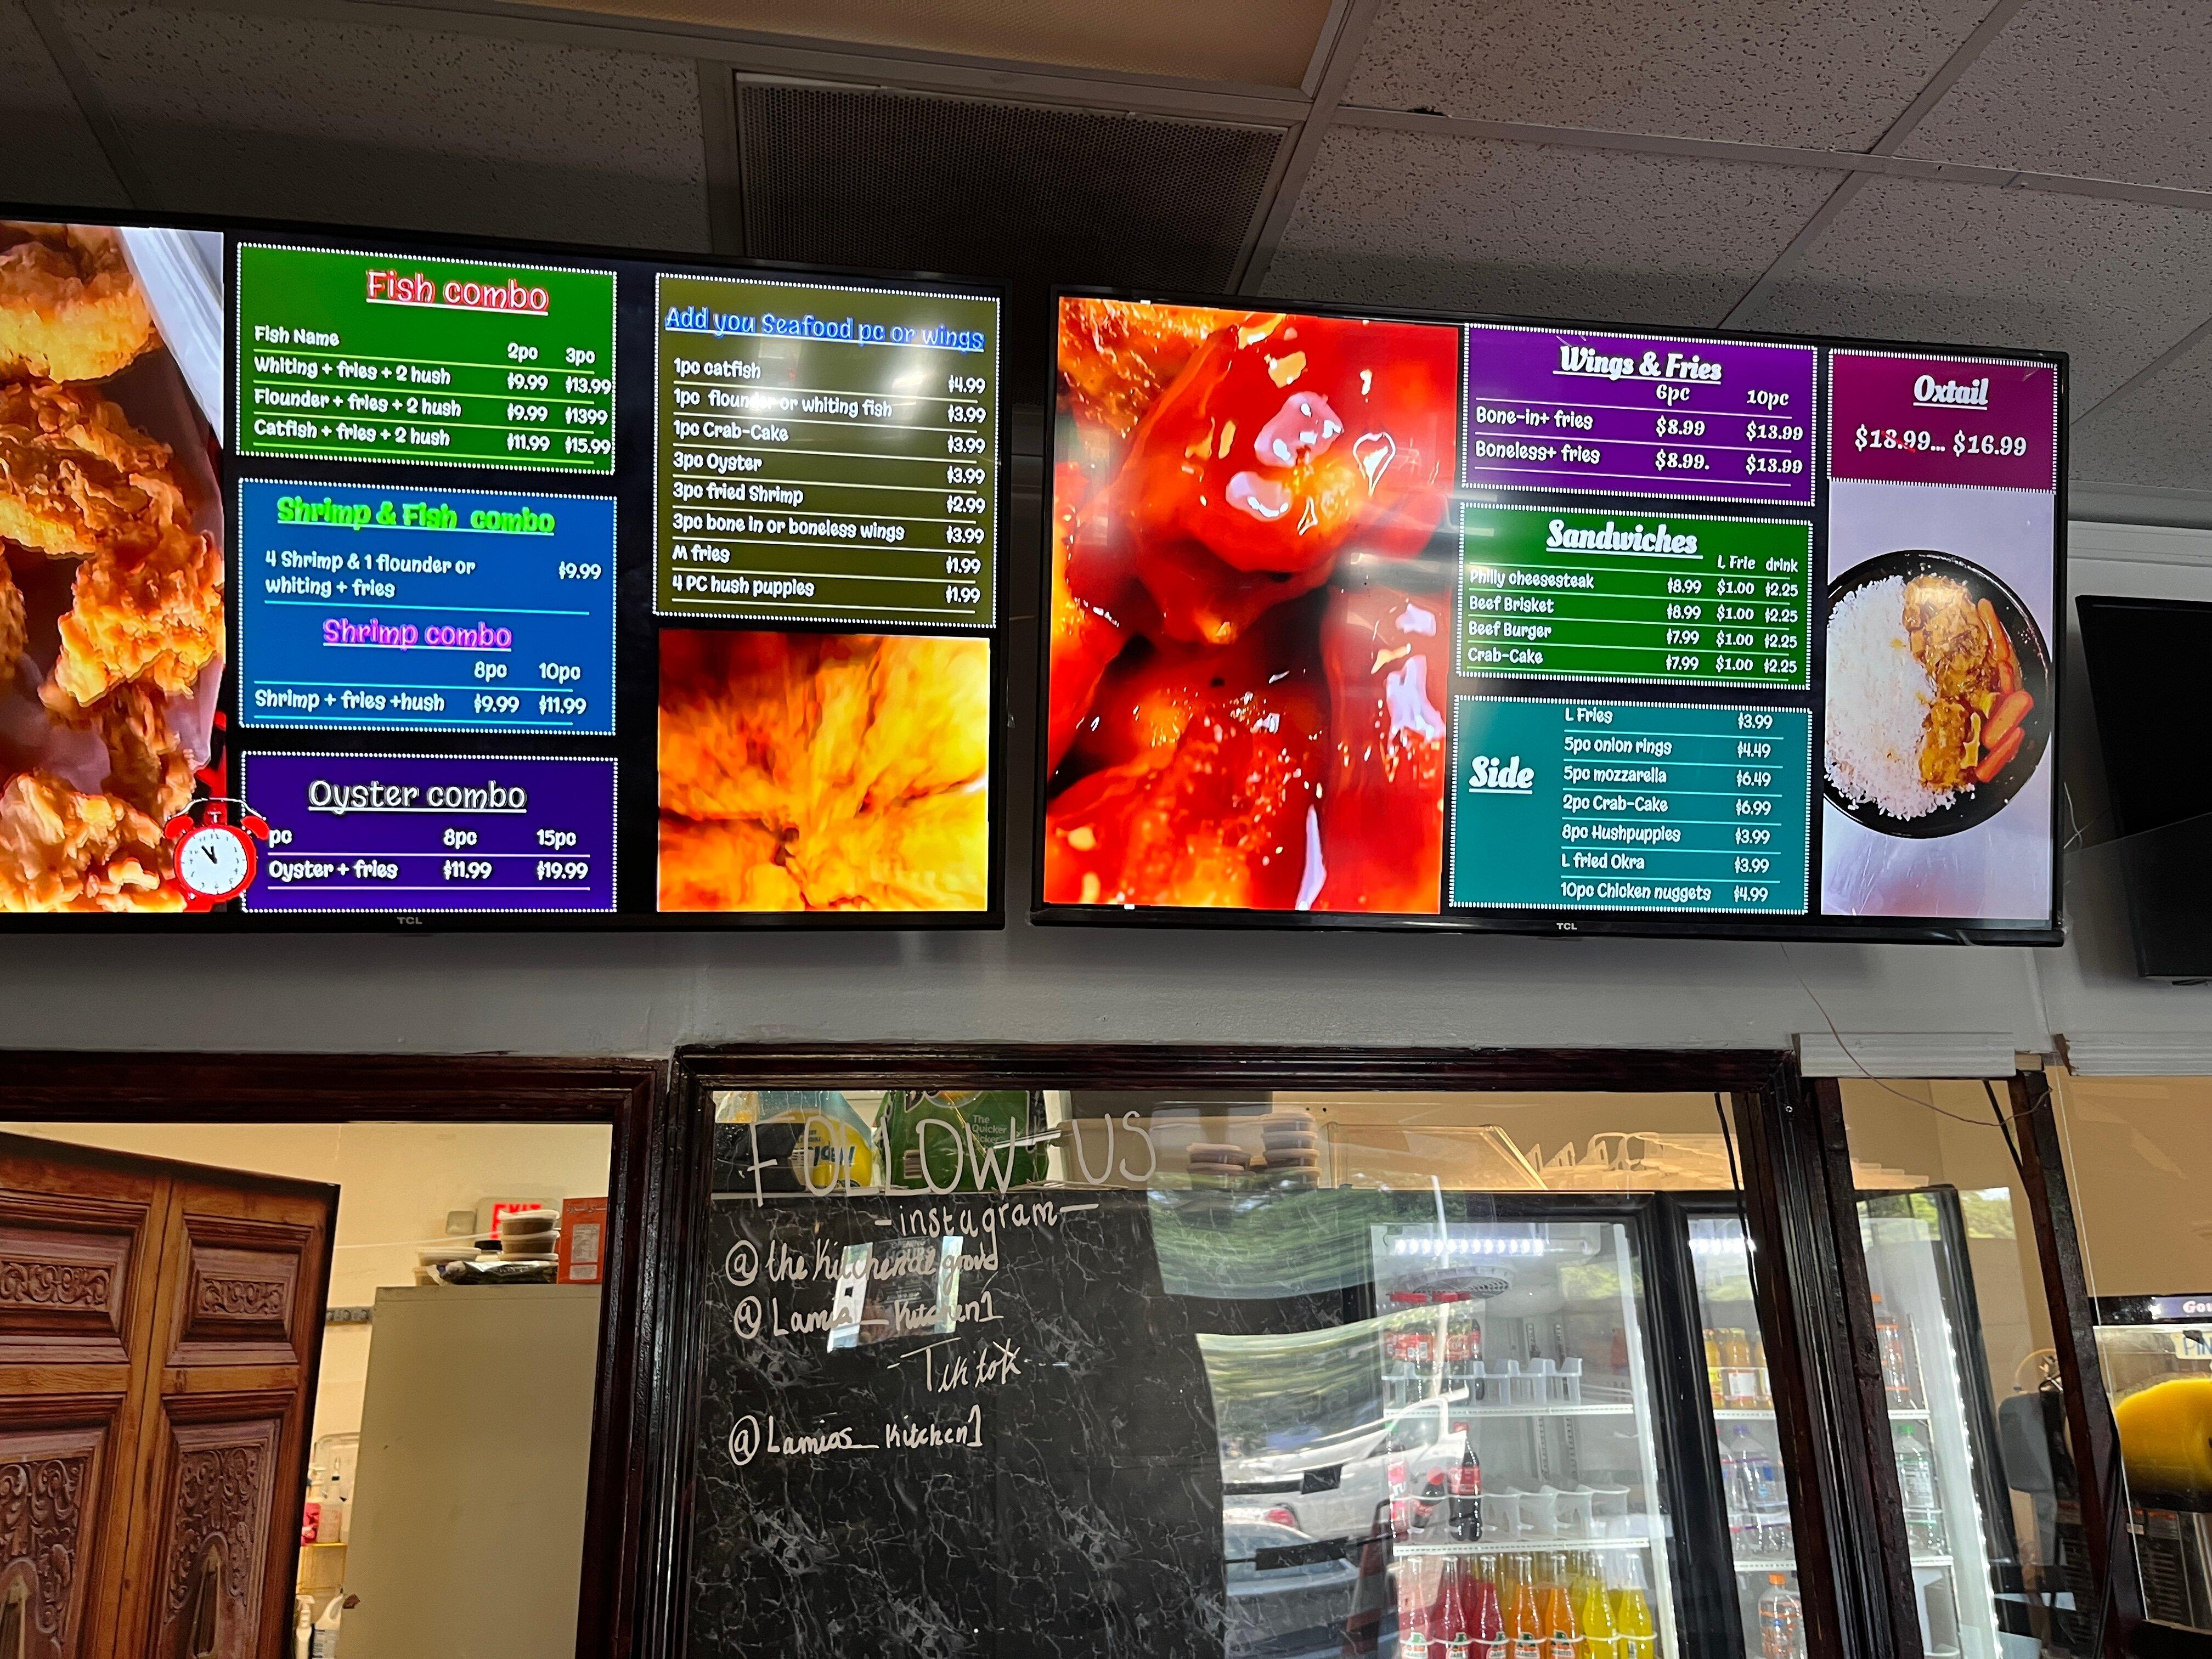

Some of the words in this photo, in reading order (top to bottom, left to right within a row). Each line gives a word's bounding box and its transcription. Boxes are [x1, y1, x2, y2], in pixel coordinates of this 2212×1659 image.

[366, 270, 435, 304] Fish
[444, 279, 549, 312] combo
[255, 325, 290, 344] Fish
[293, 329, 340, 347] Name
[665, 307, 708, 331] Add
[713, 313, 755, 338] you
[761, 313, 854, 341] Seafood
[857, 323, 887, 346] pc
[890, 324, 917, 344] or
[921, 325, 985, 351] wings
[254, 356, 318, 379] Whiting
[336, 360, 378, 380] fries
[411, 365, 451, 385] hush
[507, 372, 549, 391] $9.99
[565, 375, 612, 394] $13.99
[703, 359, 761, 380] catfish
[948, 374, 986, 394] $4.99
[1560, 345, 1634, 382] Wings
[1665, 351, 1722, 382] Fries
[1656, 384, 1690, 407] 6pc
[1746, 390, 1789, 411] 10pc
[1914, 375, 1989, 405] Oxtail
[254, 387, 330, 408] Flounder
[347, 393, 389, 413] fries
[421, 397, 461, 417] hush
[507, 403, 548, 422] $9.99
[565, 407, 608, 425] $1399
[779, 397, 799, 410] or
[801, 396, 859, 418] whiting
[862, 399, 893, 418] fish
[947, 404, 986, 424] $3.99
[254, 419, 318, 438] Catfish
[335, 422, 377, 443] fries
[410, 427, 450, 446] hush
[507, 433, 550, 452] $11.99
[565, 436, 612, 455] $15.99
[702, 421, 789, 442] Crab-Cake
[947, 435, 986, 454] $3.99
[1476, 405, 1550, 427] Bone-in+
[1554, 409, 1593, 430] fries
[1656, 415, 1705, 437] $8.99
[1746, 420, 1803, 442] $13.99
[1476, 439, 1557, 461] Boneless+
[1560, 443, 1600, 464] fries
[1655, 448, 1709, 471] $8.99.
[1746, 453, 1803, 475] $13.99
[1953, 430, 2027, 457] $16.99
[706, 453, 763, 475] Oyster
[947, 465, 985, 484] $3.99
[706, 482, 746, 501] fried
[748, 484, 804, 507] Shrimp
[946, 495, 986, 514] $2.99
[278, 495, 372, 531] Shrimp
[402, 503, 457, 528] Fish
[470, 507, 555, 534] combo
[706, 513, 746, 532] bone
[748, 515, 764, 533] in
[766, 519, 786, 534] or
[788, 517, 857, 538] boneless
[860, 521, 905, 543] wings
[946, 525, 985, 544] $3.99
[1546, 518, 1698, 555] Sandwiches
[281, 550, 343, 573] Shrimp
[376, 554, 452, 573] flounder
[455, 560, 476, 574] or
[558, 561, 602, 580] $9.99
[690, 544, 730, 563] fries
[946, 556, 981, 574] $1.99
[1729, 555, 1756, 569] Frie
[1765, 557, 1798, 573] drink
[265, 575, 332, 598] whiting
[352, 578, 396, 598] fries
[686, 575, 708, 592] PC
[710, 575, 749, 594] hush
[945, 585, 981, 603] $1.99
[1469, 568, 1505, 590] Philly
[1508, 570, 1594, 589] cheesesteak
[1667, 577, 1702, 594] $8.99
[1717, 578, 1754, 596] $1.00
[1765, 582, 1798, 597] $2.25
[1469, 595, 1502, 611] Beef
[1504, 596, 1554, 613] Brisket
[1667, 603, 1701, 620] $8.99
[1716, 604, 1754, 622] $1.00
[1764, 607, 1798, 623] $2.25
[323, 618, 418, 650] Shrimp
[424, 622, 512, 648] combo
[1468, 620, 1502, 636] Beef
[1503, 622, 1552, 641] Burger
[1666, 628, 1700, 645] $7.99
[1716, 630, 1754, 648] $1.00
[1764, 633, 1798, 649] $2.25
[1467, 646, 1543, 664] Crab-Cake
[1666, 654, 1699, 670] $7.99
[1716, 654, 1753, 673] $1.00
[1764, 658, 1797, 674] $2.25
[255, 689, 320, 712] Shrimp
[340, 690, 386, 710] fries
[390, 692, 445, 712] +hush
[474, 693, 520, 713] $9.99
[539, 695, 586, 715] $11.99
[1577, 707, 1613, 724] Fries
[1737, 712, 1773, 730] $3.99
[1594, 736, 1633, 753] onion
[1635, 738, 1672, 757] rings
[1737, 741, 1771, 758] $4.49
[1468, 754, 1534, 789] Side
[1593, 766, 1667, 783] mozzarella
[1736, 770, 1771, 787] $6.49
[308, 778, 420, 816] Oyster
[427, 780, 527, 810] combo
[1593, 794, 1668, 812] Crab-Cake
[1736, 798, 1771, 816] $6.99
[1591, 825, 1681, 845] Hushpuppies
[1735, 827, 1770, 845] $3.99
[269, 860, 334, 883] Oyster
[353, 859, 398, 879] fries
[443, 860, 492, 881] $11.99
[537, 860, 589, 881] $19.99
[1572, 852, 1608, 868] fried
[1611, 853, 1645, 870] Okra
[1734, 856, 1769, 873] $3.99
[1654, 885, 1712, 902] nuggets
[1734, 885, 1768, 902] $4.99
[396, 916, 423, 924] TCL
[1556, 922, 1578, 930] TCL
[972, 1124, 1007, 1135] Quicker
[973, 1114, 990, 1124] The
[747, 1115, 1017, 1207] FOLLOW
[1072, 1110, 1157, 1185] US
